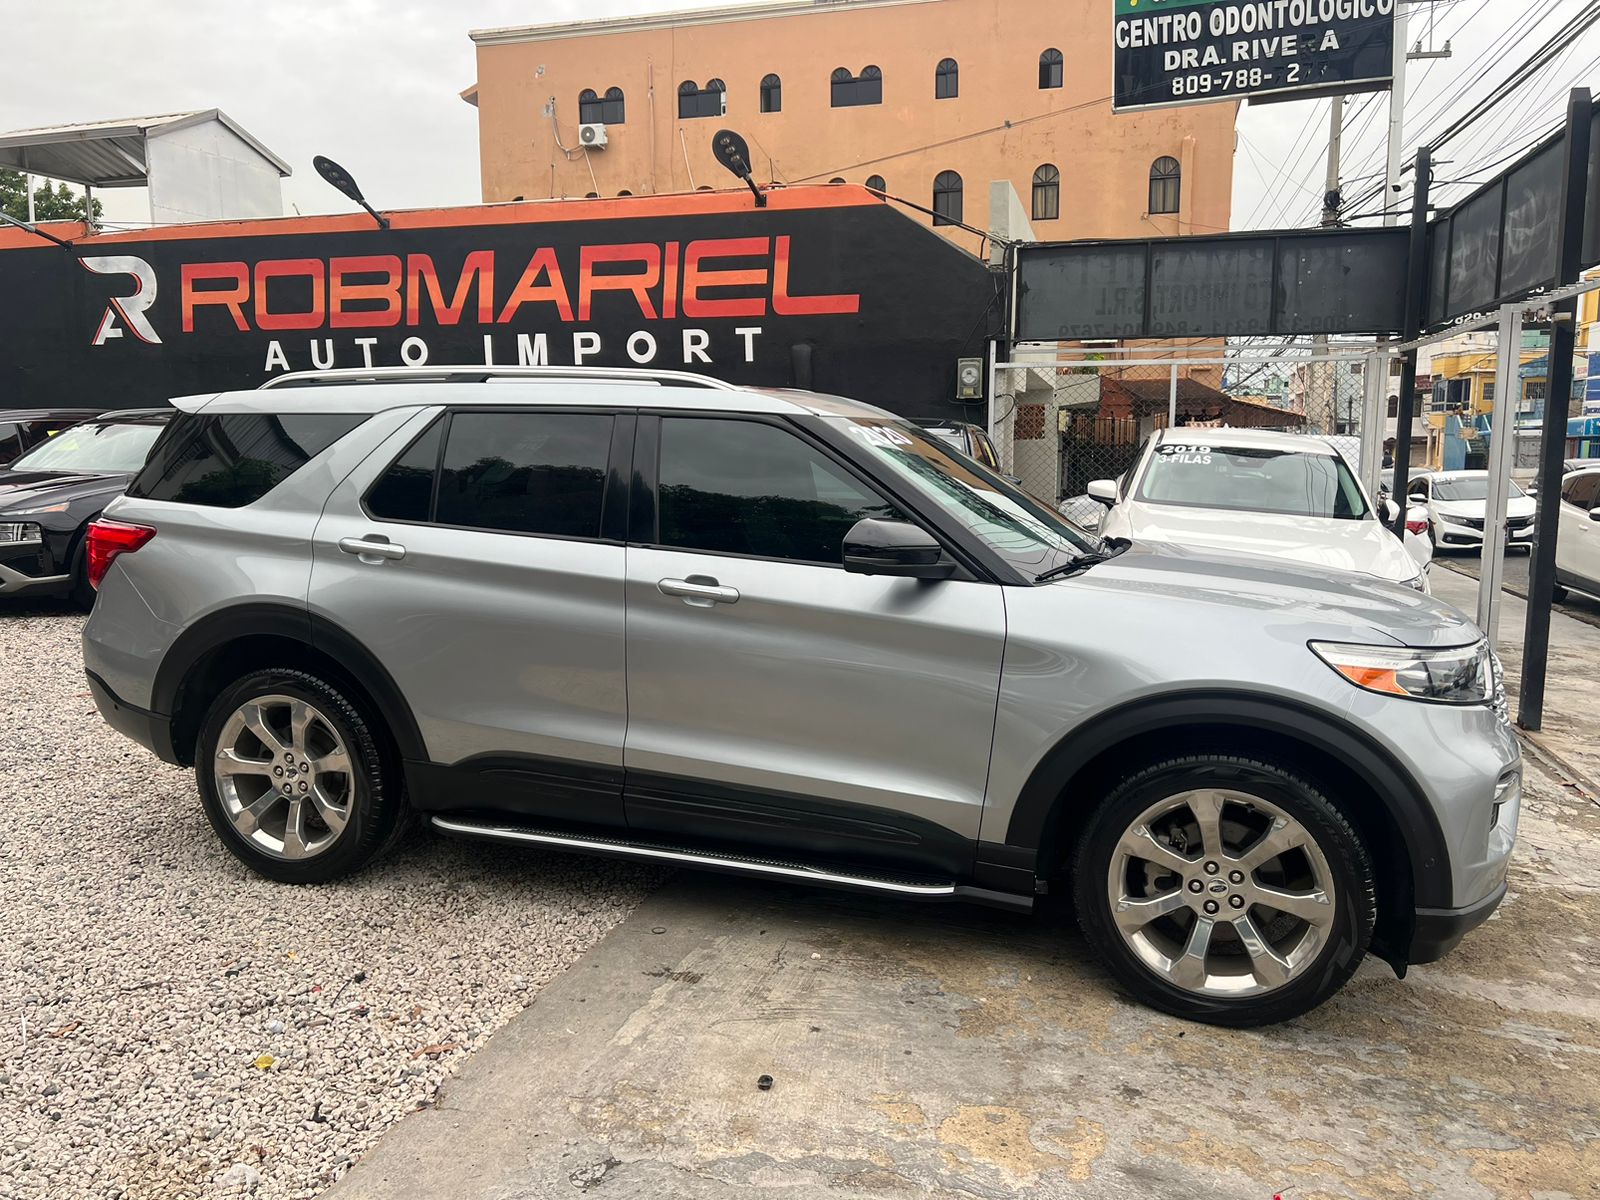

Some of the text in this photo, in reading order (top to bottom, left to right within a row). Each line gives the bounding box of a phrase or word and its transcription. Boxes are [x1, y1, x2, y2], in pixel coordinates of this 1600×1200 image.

[1115, 11, 1202, 49] CENTRO
[1164, 46, 1227, 71] DRA.
[1172, 61, 1329, 97] 809-788-2
[180, 236, 861, 333] ROBMARIEL
[264, 327, 762, 371] AUTO IMPORT
[1158, 454, 1212, 464] 3-FILAS
[1161, 445, 1211, 454] 2019
